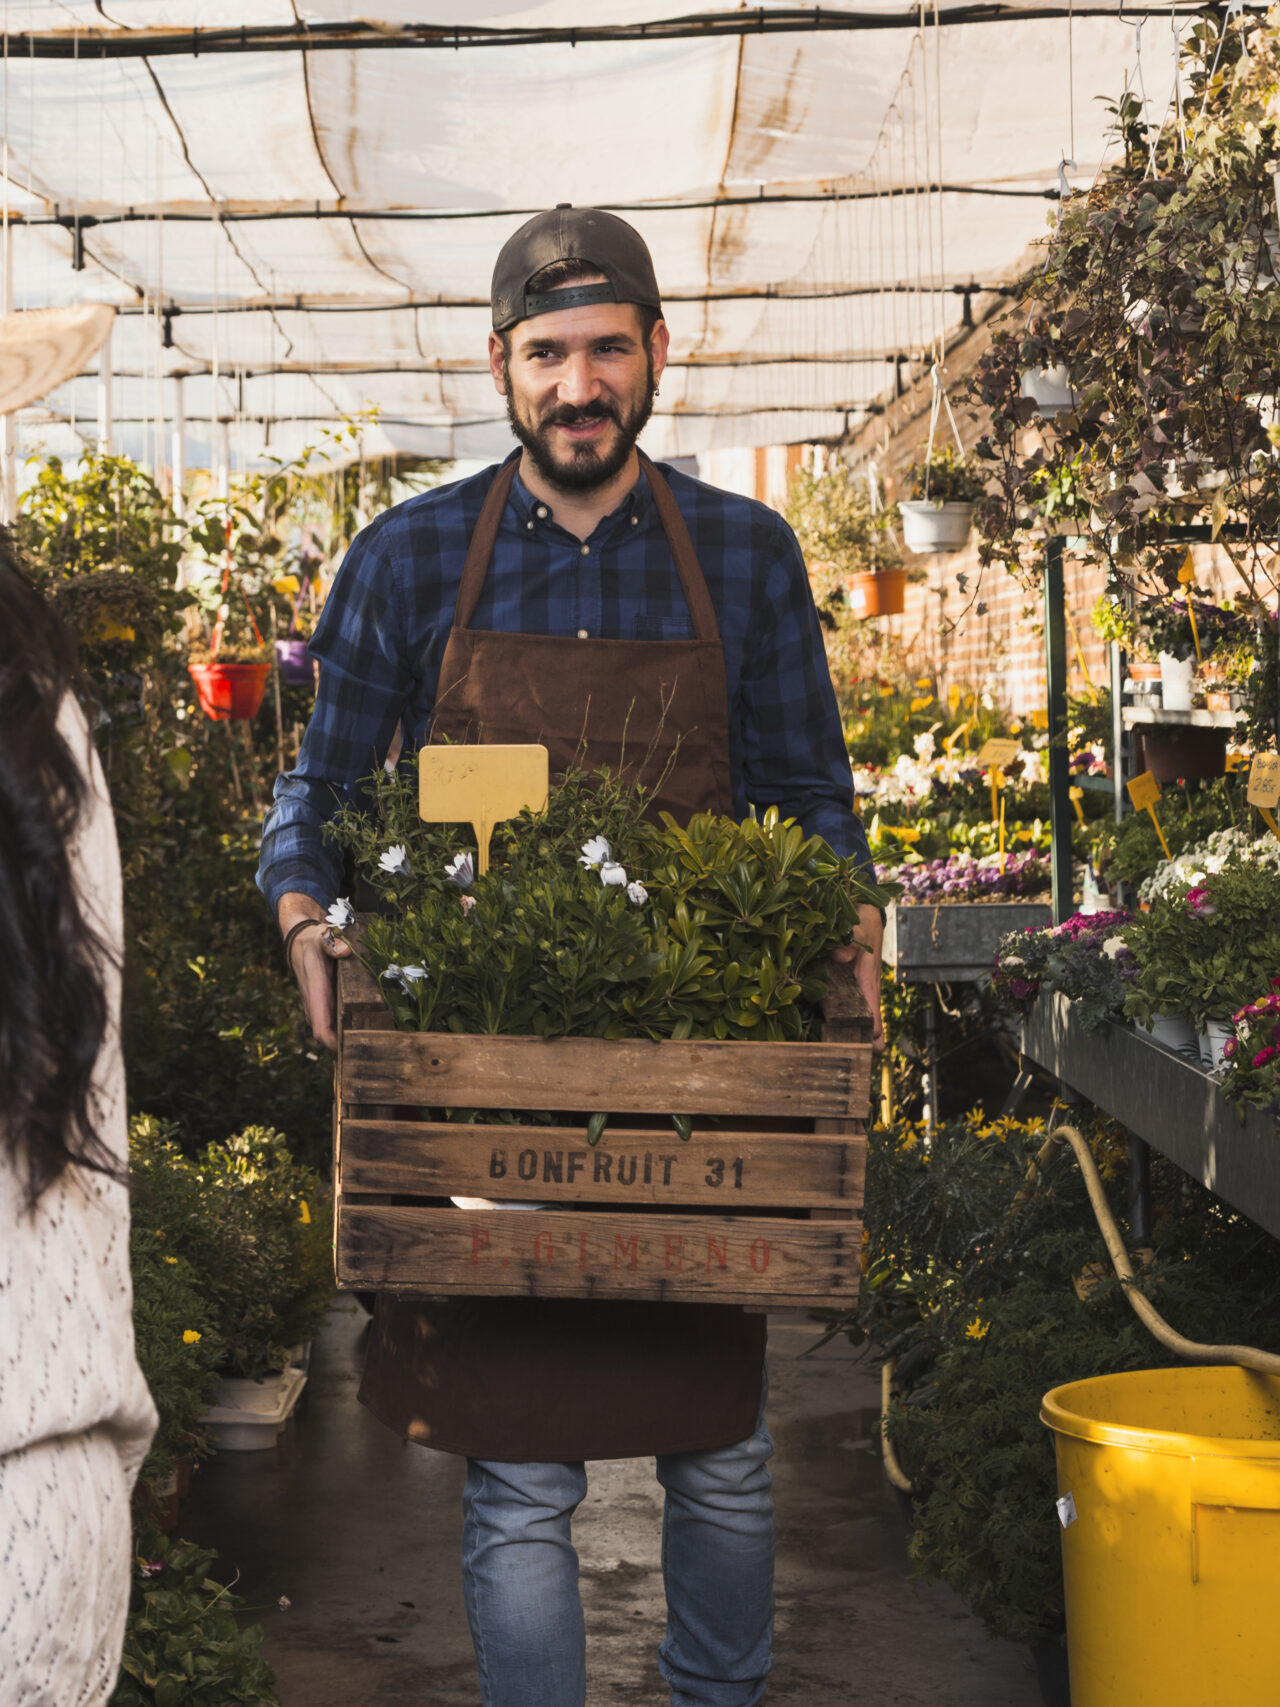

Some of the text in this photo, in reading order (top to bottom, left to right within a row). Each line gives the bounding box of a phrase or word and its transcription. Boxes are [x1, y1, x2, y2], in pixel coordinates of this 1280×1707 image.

[488, 1149, 744, 1189] BONFRUIT 31
[533, 1231, 771, 1274] GIMENO
